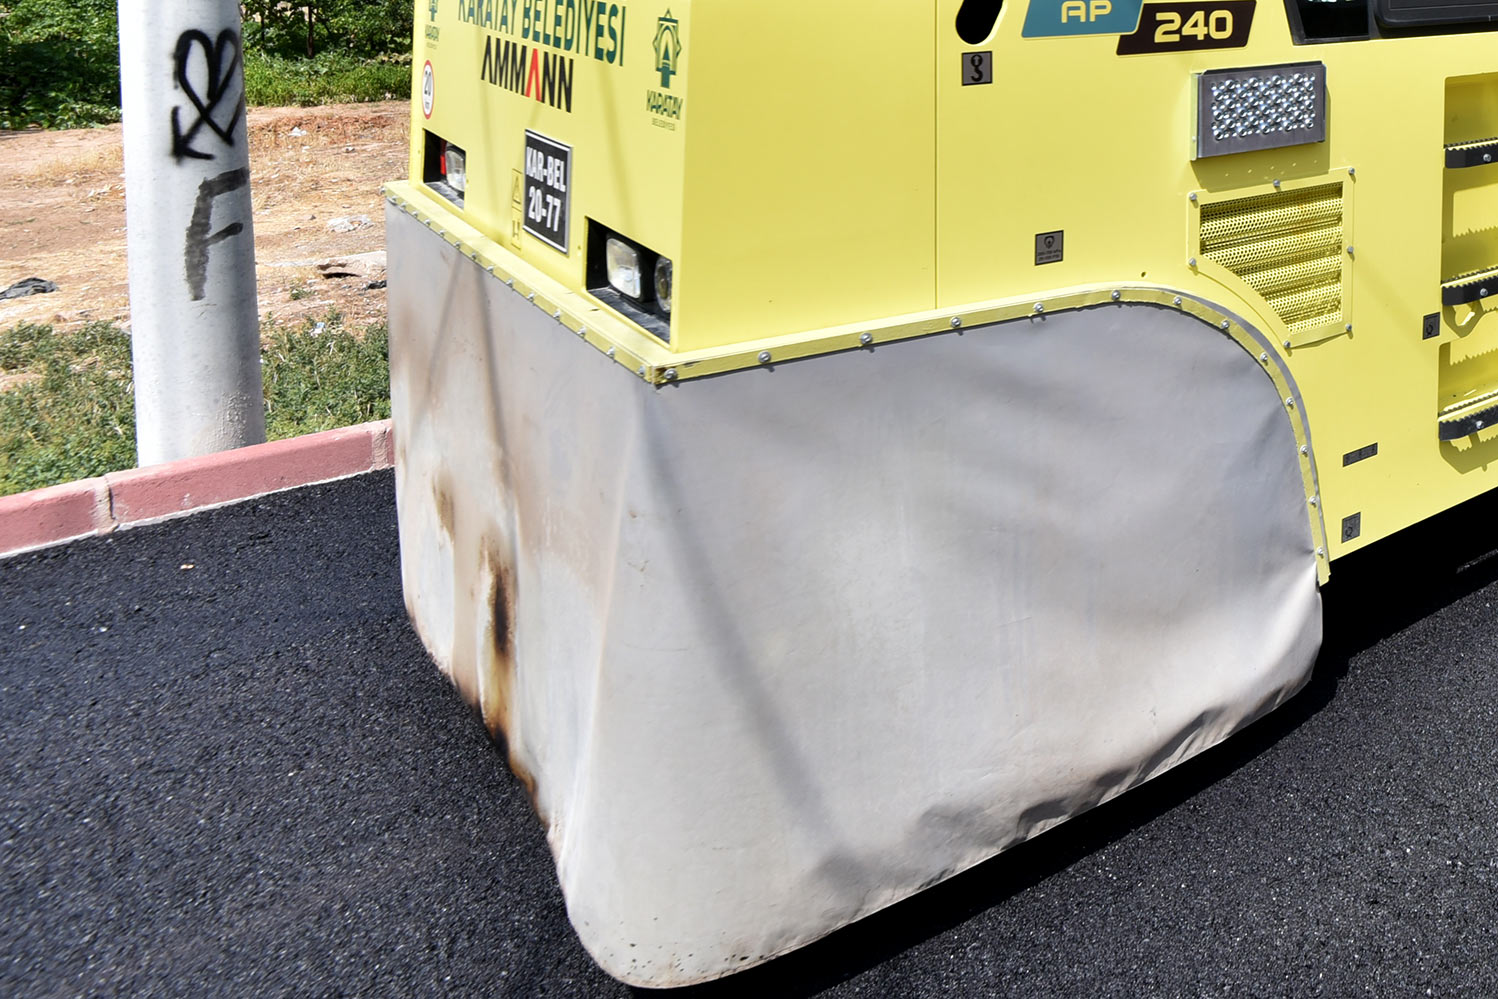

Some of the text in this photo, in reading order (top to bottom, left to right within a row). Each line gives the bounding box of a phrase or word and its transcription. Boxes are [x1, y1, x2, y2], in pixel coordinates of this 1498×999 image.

[1061, 0, 1112, 23] AP
[1154, 9, 1234, 43] 240
[480, 35, 574, 114] AMMANN
[646, 89, 683, 120] KARATAY
[526, 146, 566, 192] KAR-BEL
[528, 185, 561, 232] 20-77
